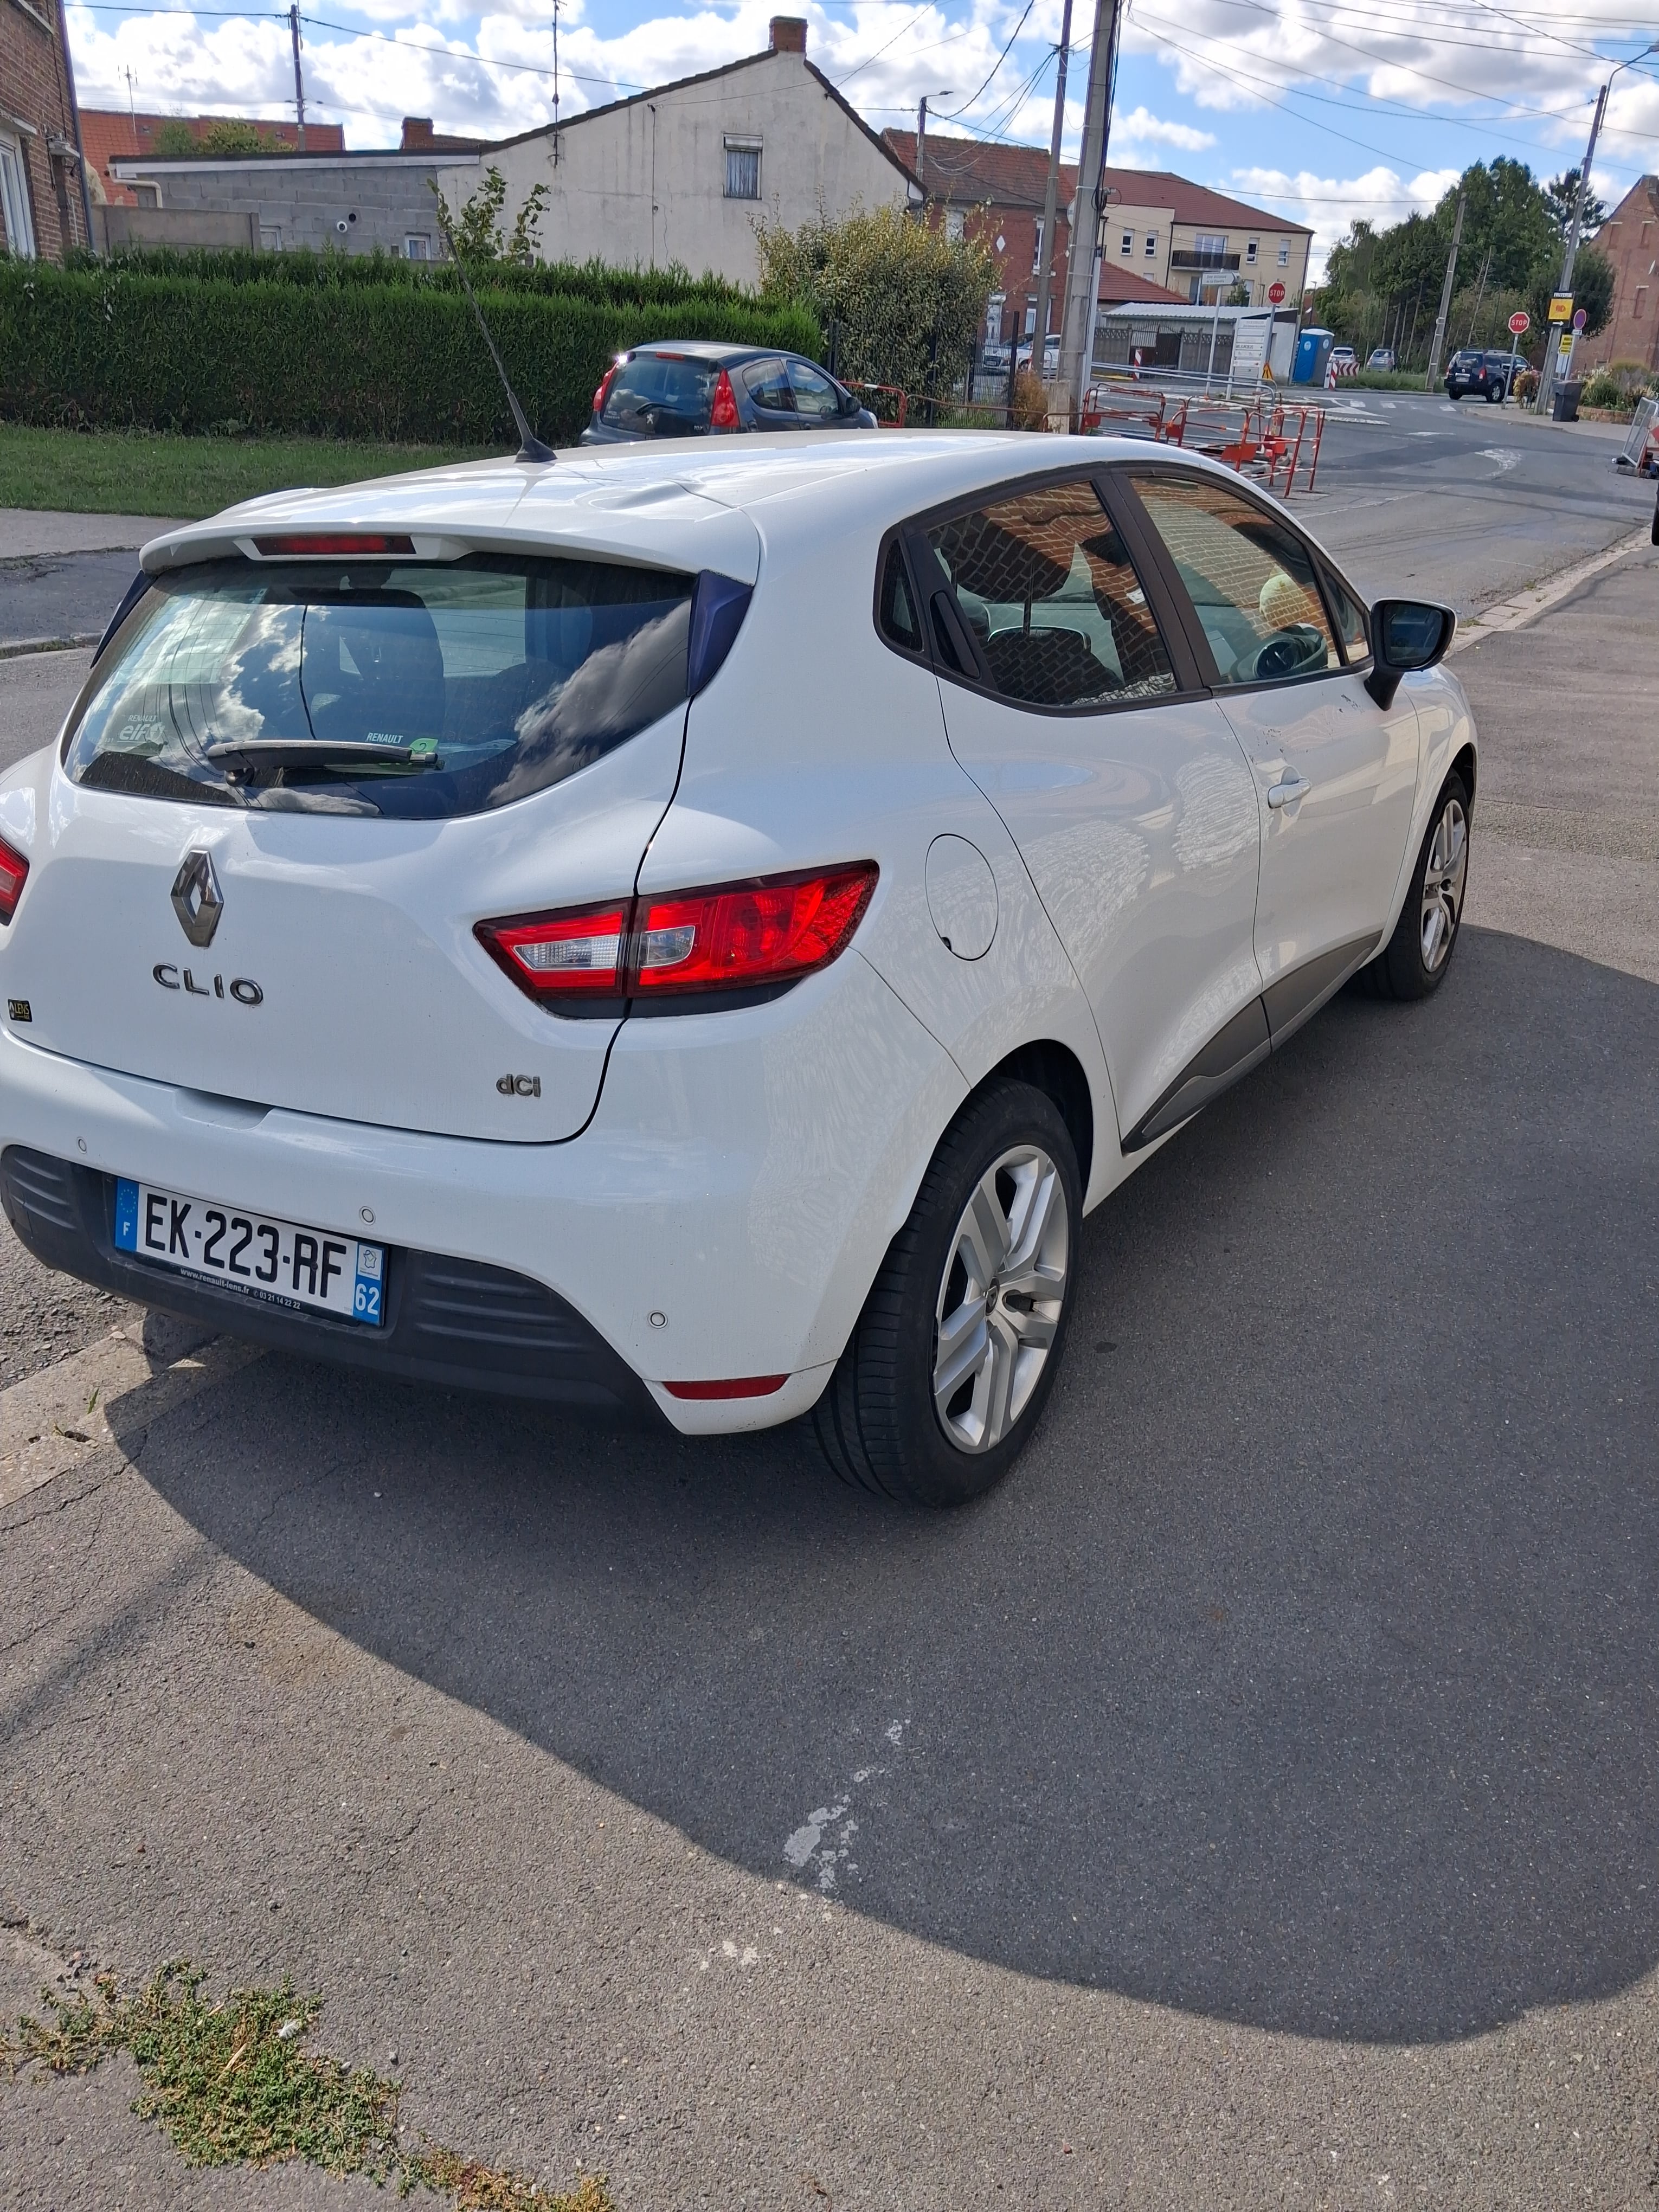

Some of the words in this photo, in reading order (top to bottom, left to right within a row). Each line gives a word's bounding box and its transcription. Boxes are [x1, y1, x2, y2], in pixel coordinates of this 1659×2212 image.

[1270, 290, 1284, 298] STOP
[120, 724, 150, 740] elf
[365, 732, 403, 744] RENAULT
[152, 962, 263, 1005] CLIO
[14, 1002, 29, 1014] LENS
[123, 1221, 131, 1236] F
[145, 1193, 347, 1298] EK-223-RF
[180, 1268, 249, 1294] www.renault-lens.fr
[355, 1283, 380, 1315] 62
